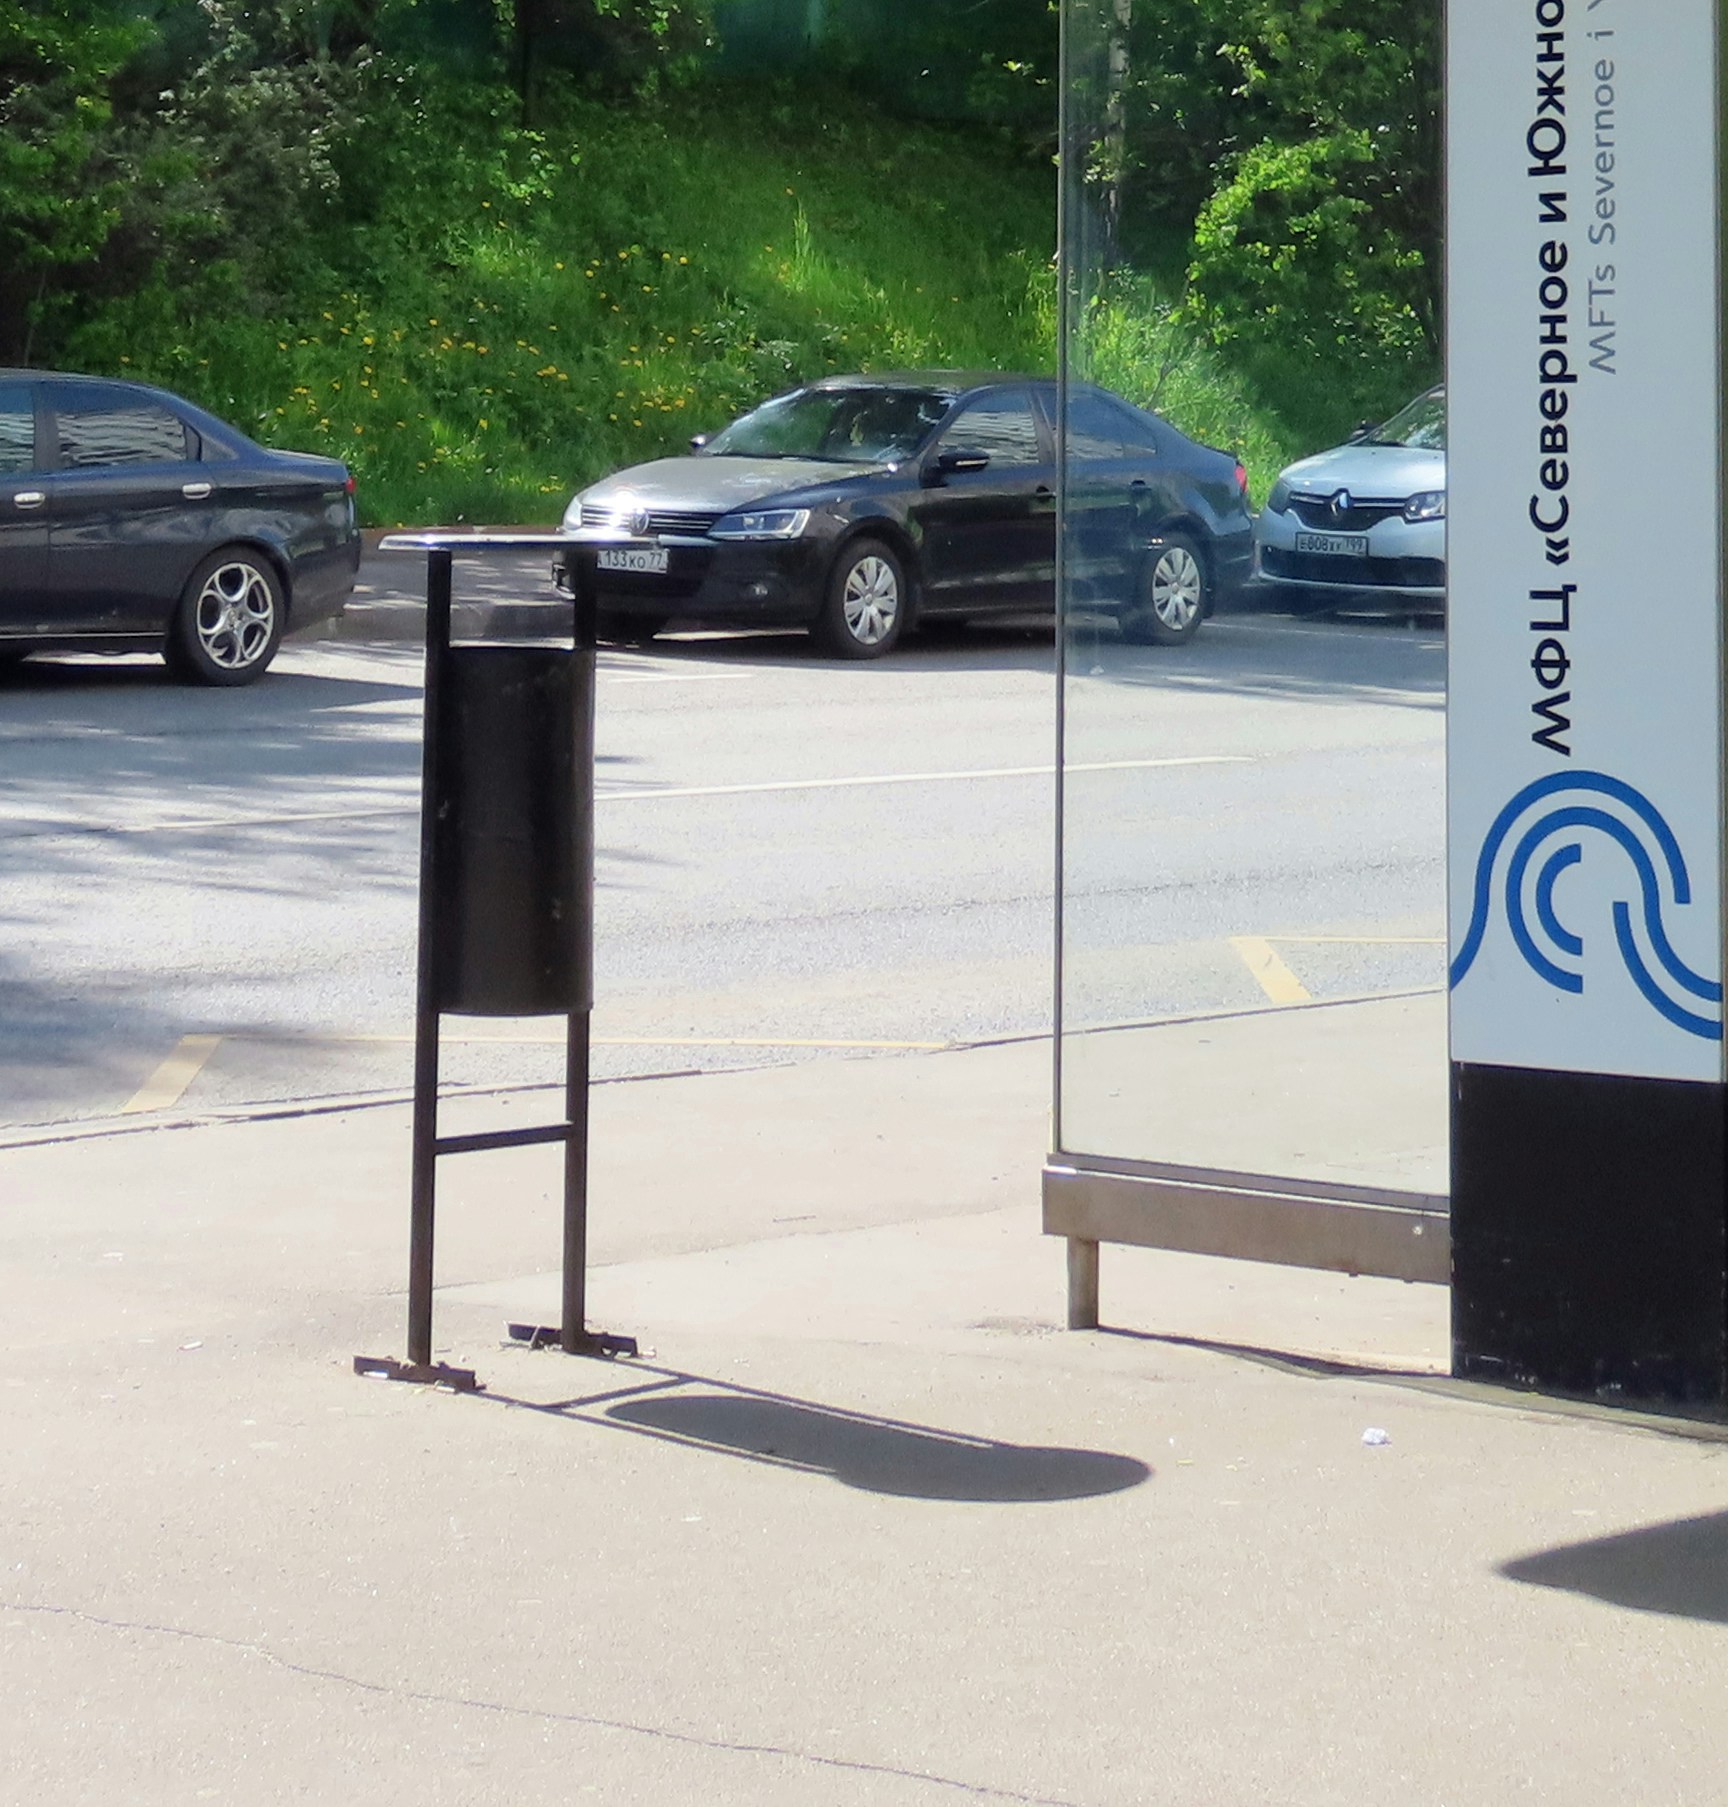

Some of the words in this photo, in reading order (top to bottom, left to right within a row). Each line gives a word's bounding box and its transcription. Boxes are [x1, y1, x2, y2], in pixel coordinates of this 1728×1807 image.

[1586, 30, 1615, 41] i
[1538, 193, 1567, 223] и
[1587, 58, 1616, 245] Severnoe
[1587, 265, 1617, 375] MFTs
[1529, 241, 1578, 566] «Северное
[1530, 585, 1577, 756] МФЦ
